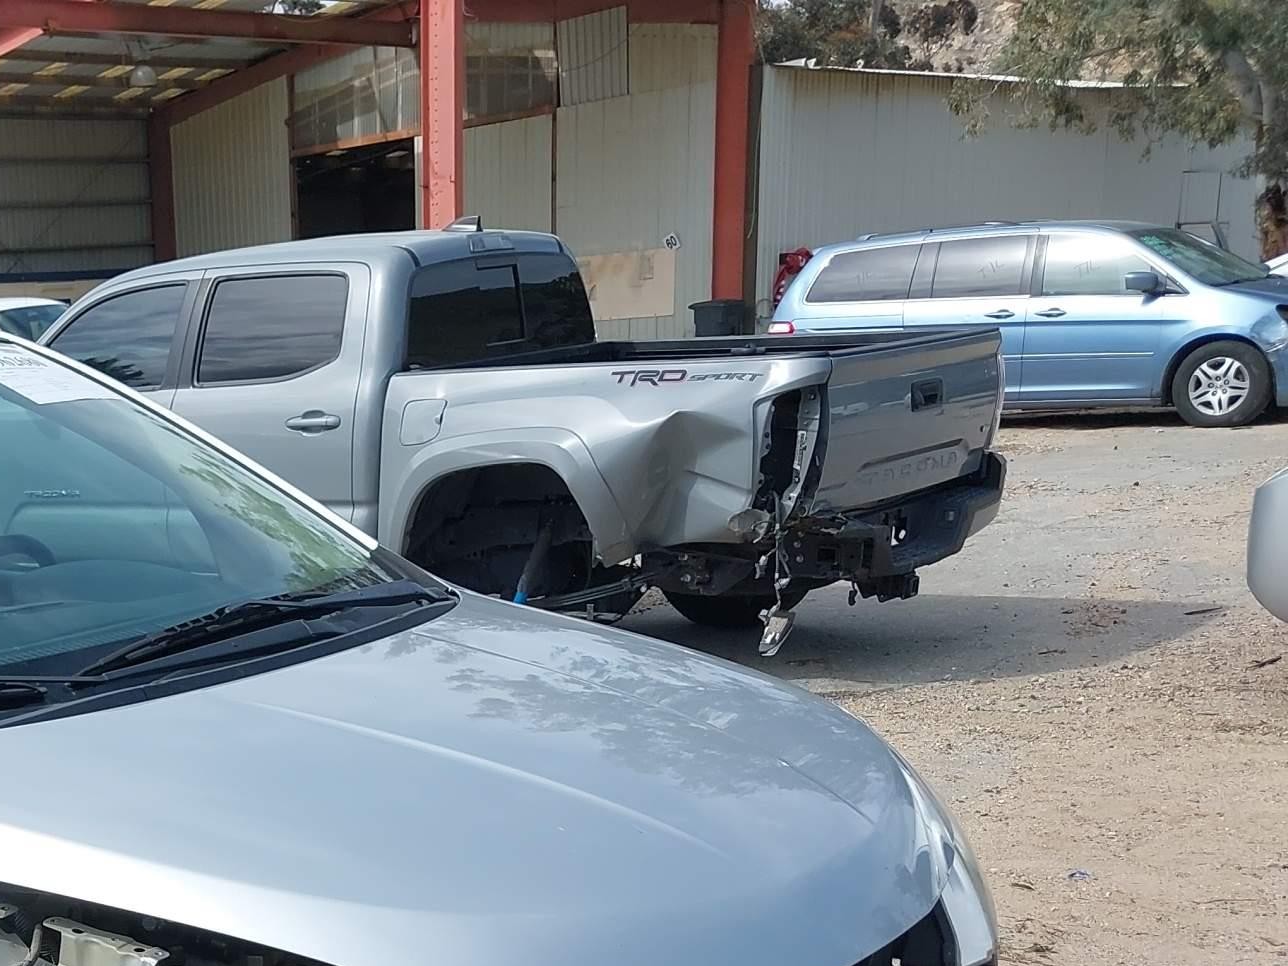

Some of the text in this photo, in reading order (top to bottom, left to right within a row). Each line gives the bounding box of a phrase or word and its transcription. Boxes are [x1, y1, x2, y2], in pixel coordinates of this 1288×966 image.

[665, 235, 677, 249] 60
[611, 369, 764, 387] TRD SPORT
